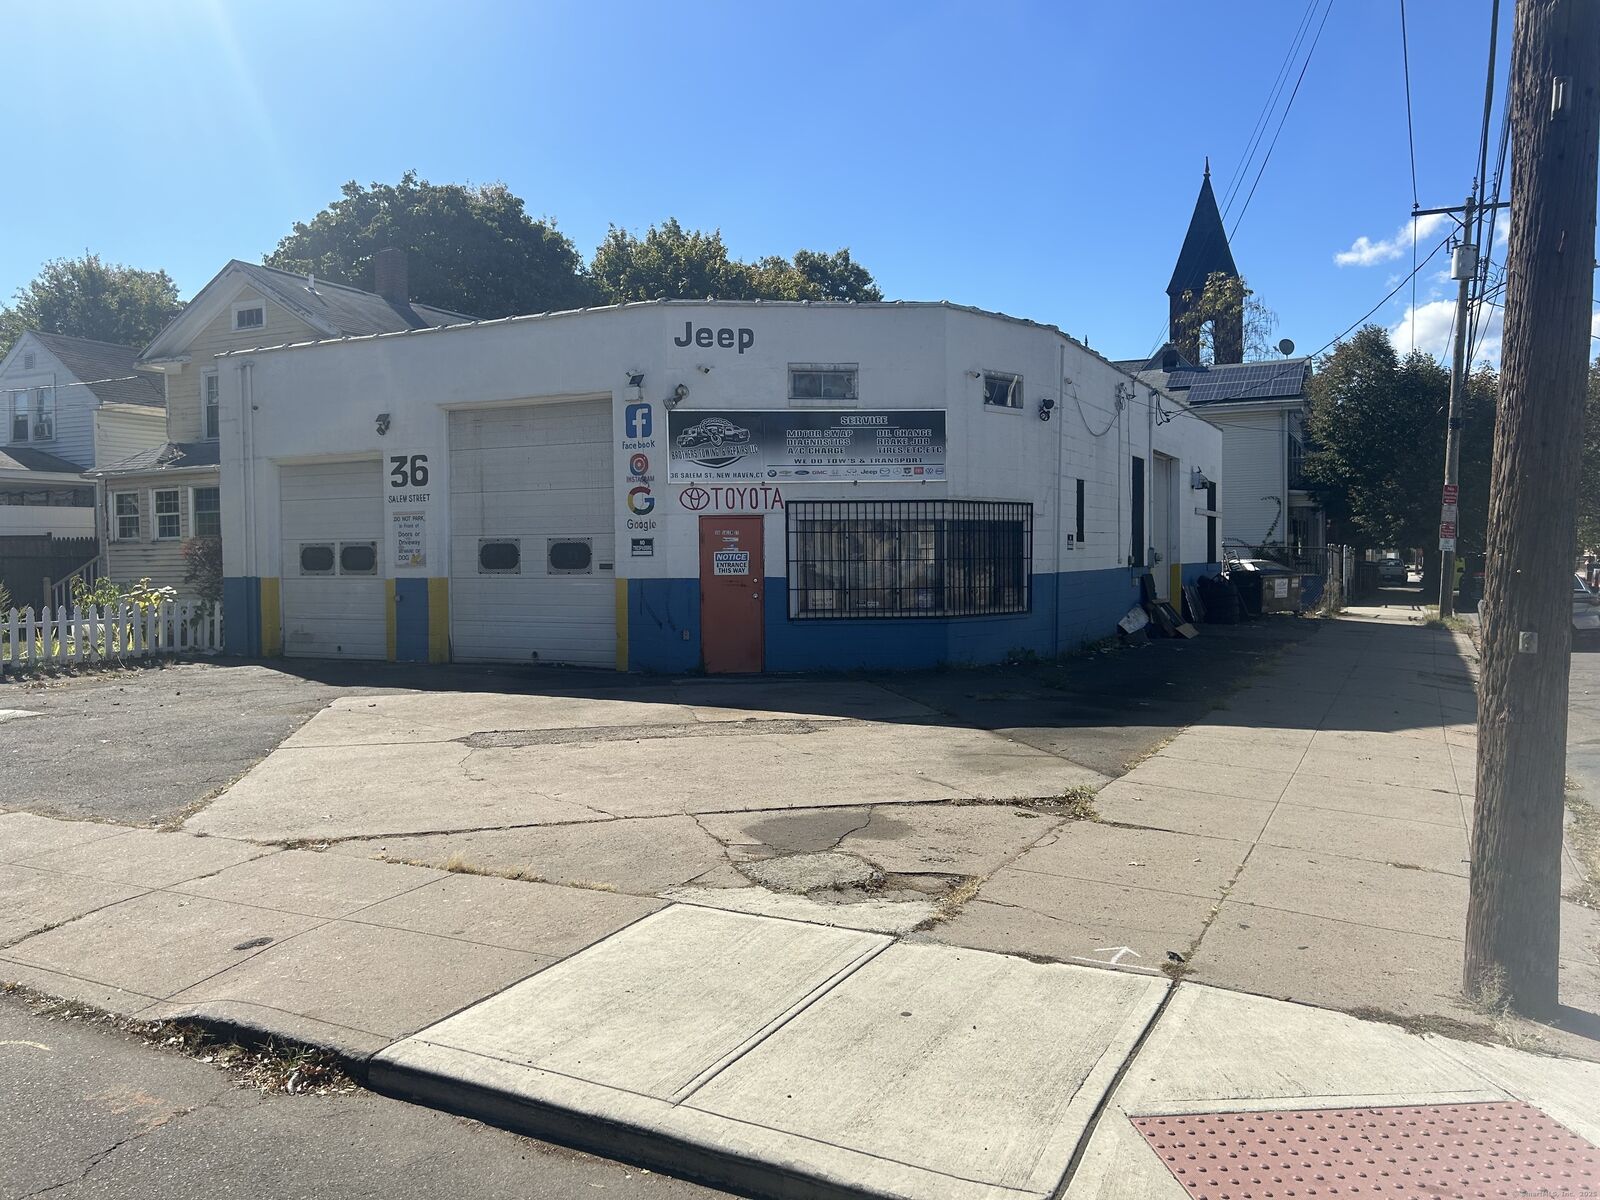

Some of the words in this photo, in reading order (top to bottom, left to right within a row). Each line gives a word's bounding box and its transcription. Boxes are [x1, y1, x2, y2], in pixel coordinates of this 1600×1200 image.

[674, 321, 754, 354] Jeep
[840, 415, 888, 425] SERVICE
[786, 429, 821, 438] MOTOR
[824, 429, 853, 438] SWAP
[876, 429, 892, 437] OIL
[894, 429, 932, 437] CHANGE
[786, 438, 851, 446] DIAGNOSTICS
[876, 437, 908, 445] BRAKE
[911, 437, 930, 445] JOB
[671, 449, 698, 460] BROTHERS
[700, 447, 719, 458] TOWING
[390, 454, 429, 488] 36
[388, 495, 408, 504] SALEM
[408, 493, 431, 503] STREET
[711, 487, 785, 510] TOYOTA
[626, 518, 657, 531] Google
[716, 553, 747, 561] NOTICE
